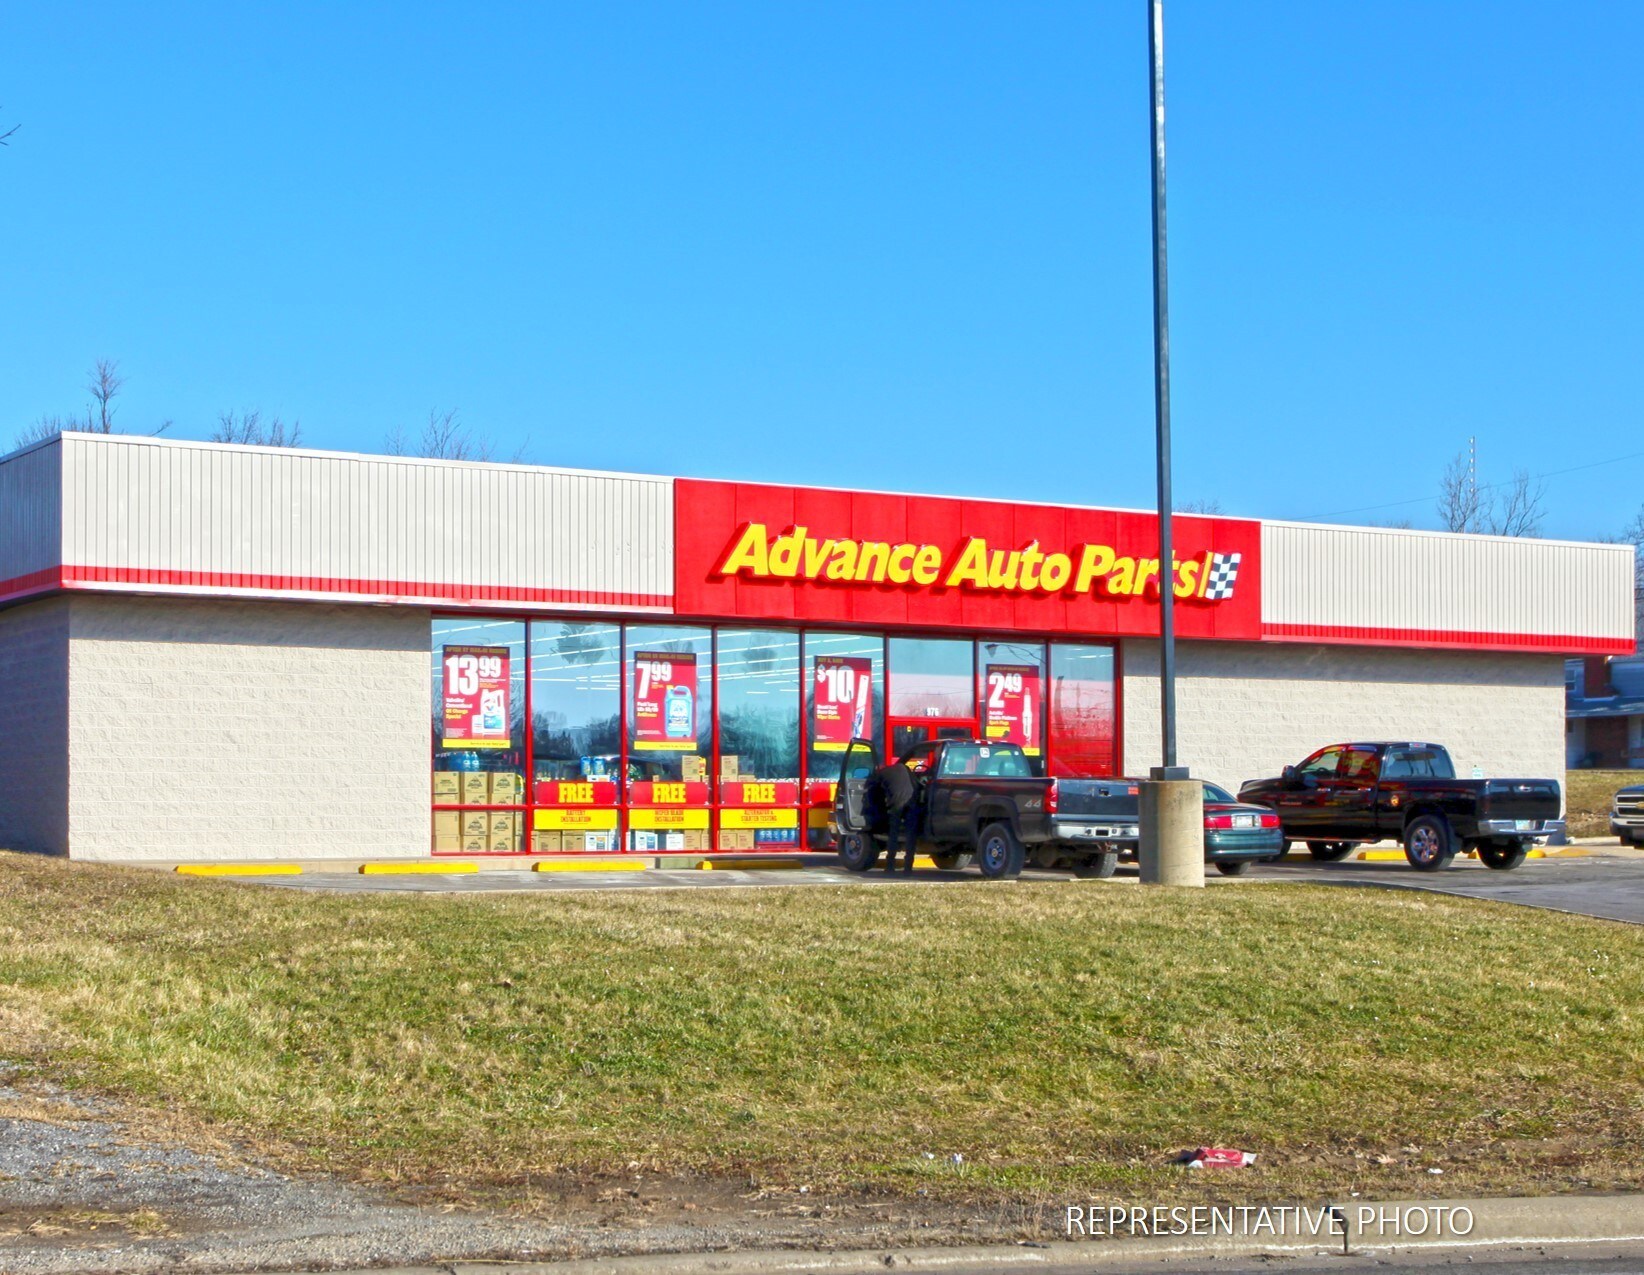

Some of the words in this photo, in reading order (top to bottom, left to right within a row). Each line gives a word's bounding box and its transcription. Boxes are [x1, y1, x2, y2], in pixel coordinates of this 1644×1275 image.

[721, 521, 942, 585] Advance
[947, 535, 1071, 592] Auto
[817, 664, 855, 703] $10
[558, 783, 594, 803] FREE
[652, 783, 686, 803] FREE
[743, 784, 776, 803] FREE
